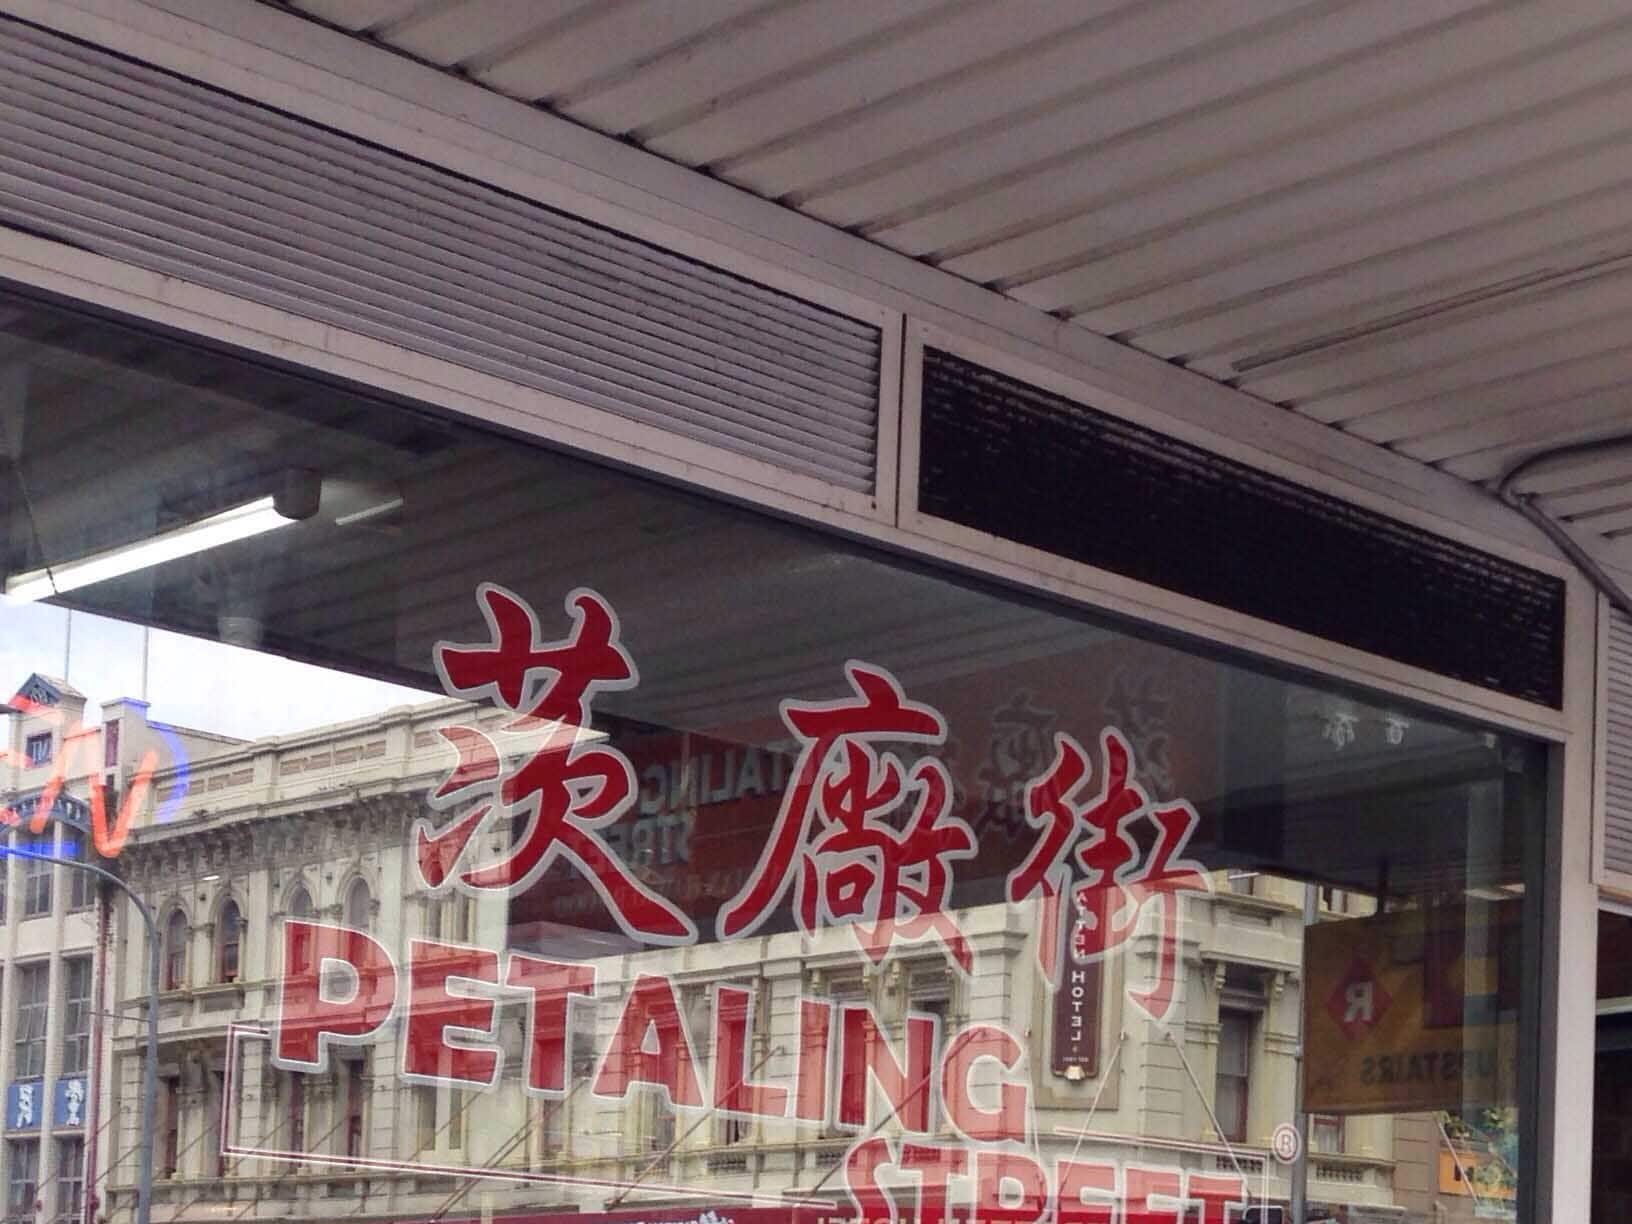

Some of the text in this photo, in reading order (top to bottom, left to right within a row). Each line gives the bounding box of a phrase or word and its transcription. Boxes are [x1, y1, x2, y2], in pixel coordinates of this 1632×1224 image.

[415, 582, 1214, 1022] 茨廠街
[272, 919, 1031, 1146] PETALING
